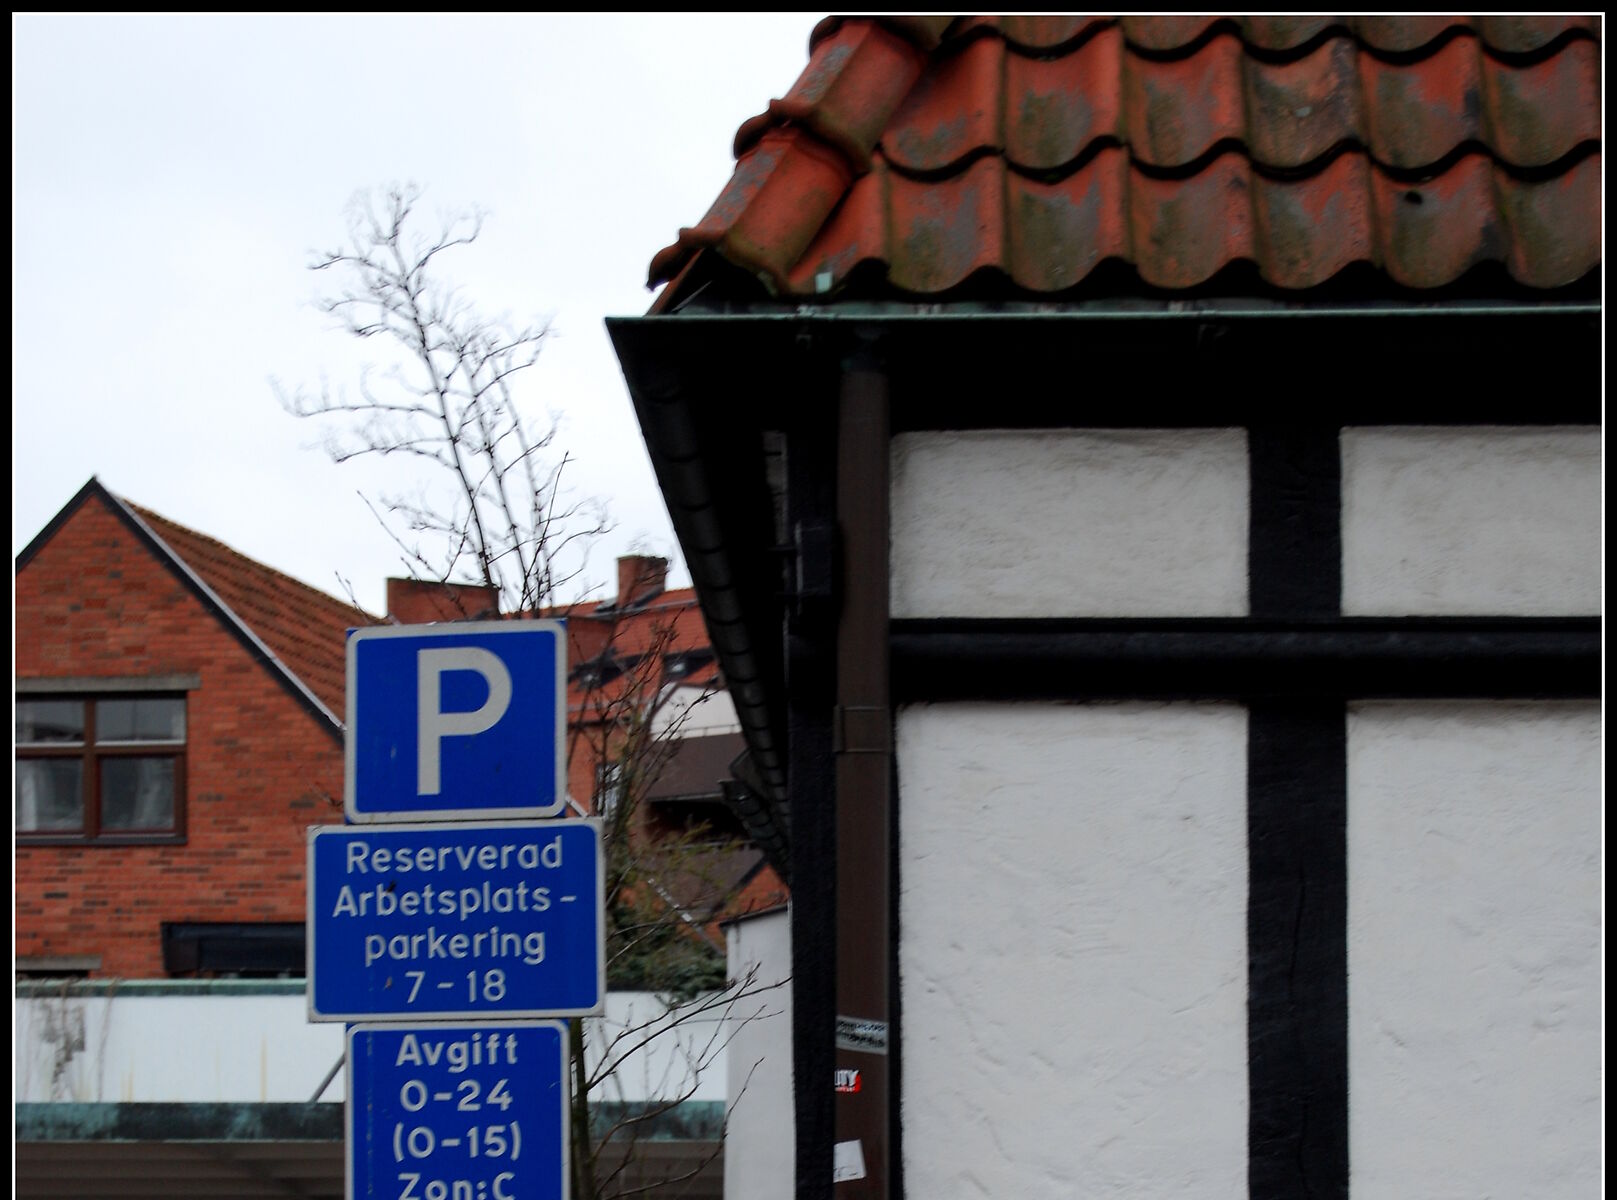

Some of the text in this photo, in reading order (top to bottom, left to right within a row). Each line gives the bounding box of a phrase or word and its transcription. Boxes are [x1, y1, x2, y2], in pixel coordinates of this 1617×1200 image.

[418, 647, 512, 795] P
[346, 835, 563, 873] Reserverad
[365, 926, 546, 966] parkering
[396, 1033, 518, 1073] Avgift
[401, 1079, 513, 1112] 0-24
[393, 1121, 522, 1162] (0-15)
